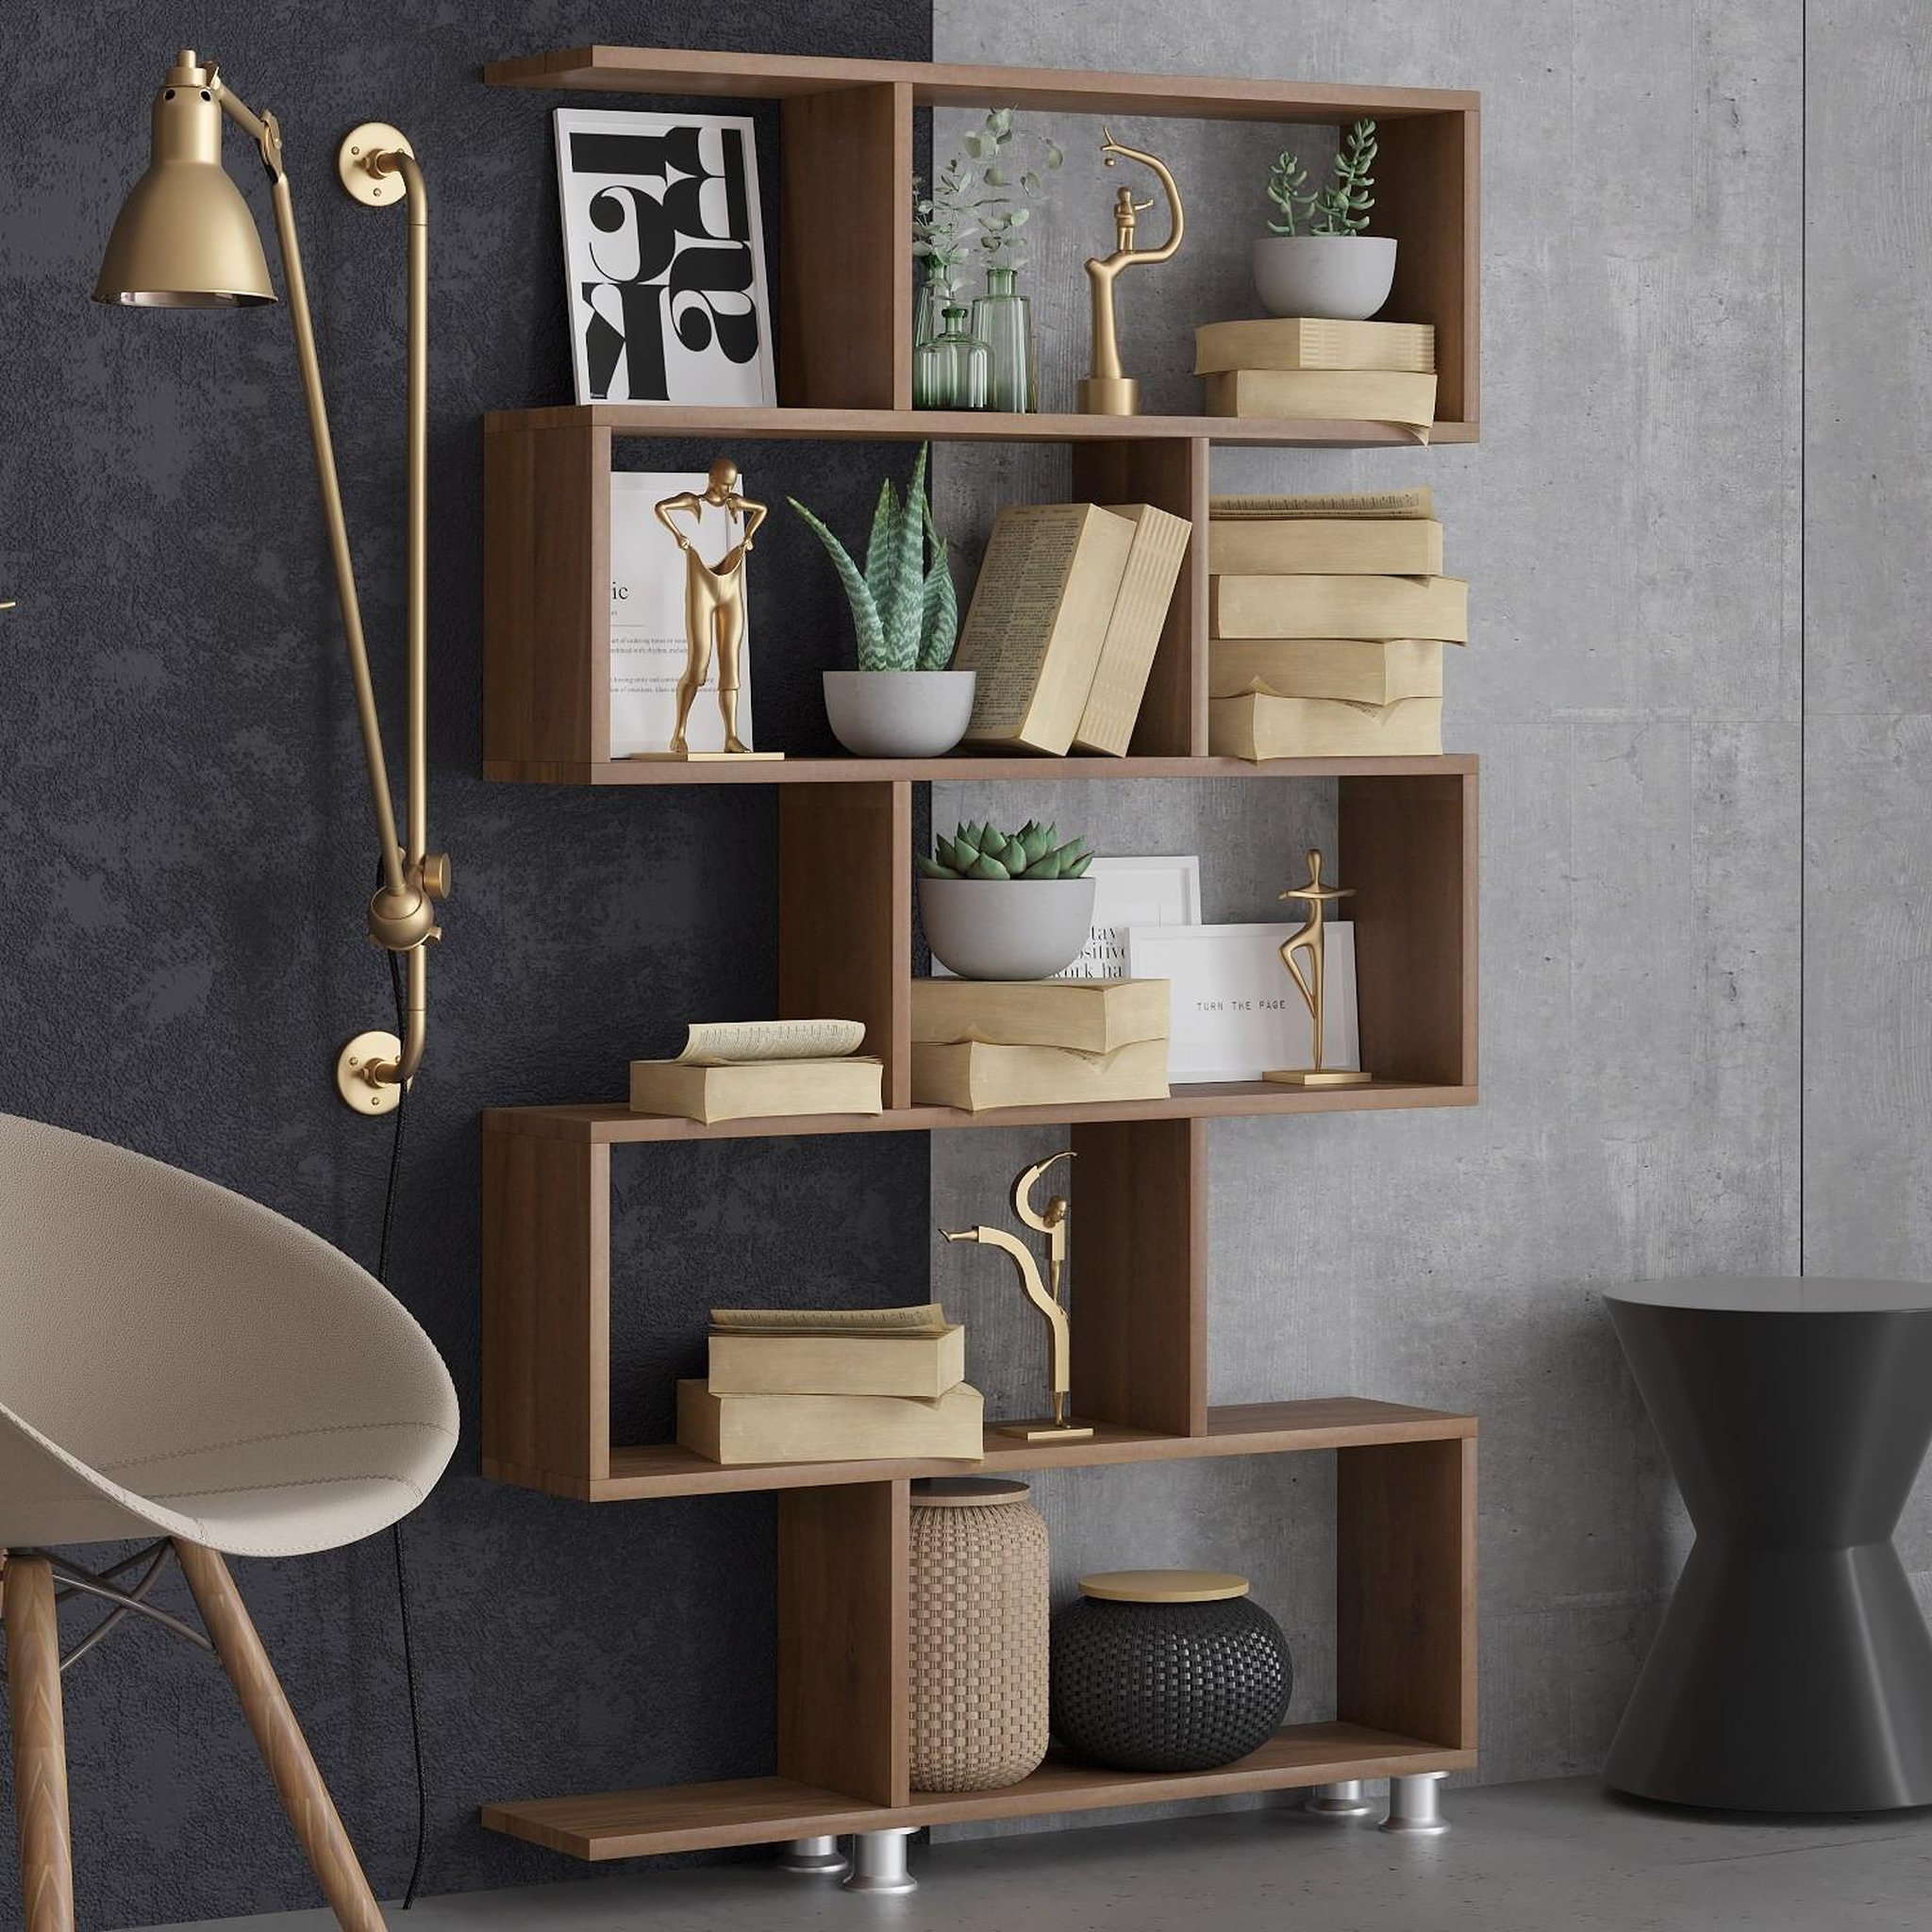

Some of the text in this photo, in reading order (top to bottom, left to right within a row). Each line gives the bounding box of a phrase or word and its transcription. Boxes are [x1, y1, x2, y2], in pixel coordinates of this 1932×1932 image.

[612, 581, 629, 600] ic
[1091, 925, 1115, 944] tay
[1196, 1000, 1286, 1011] TURN THE PAGE
